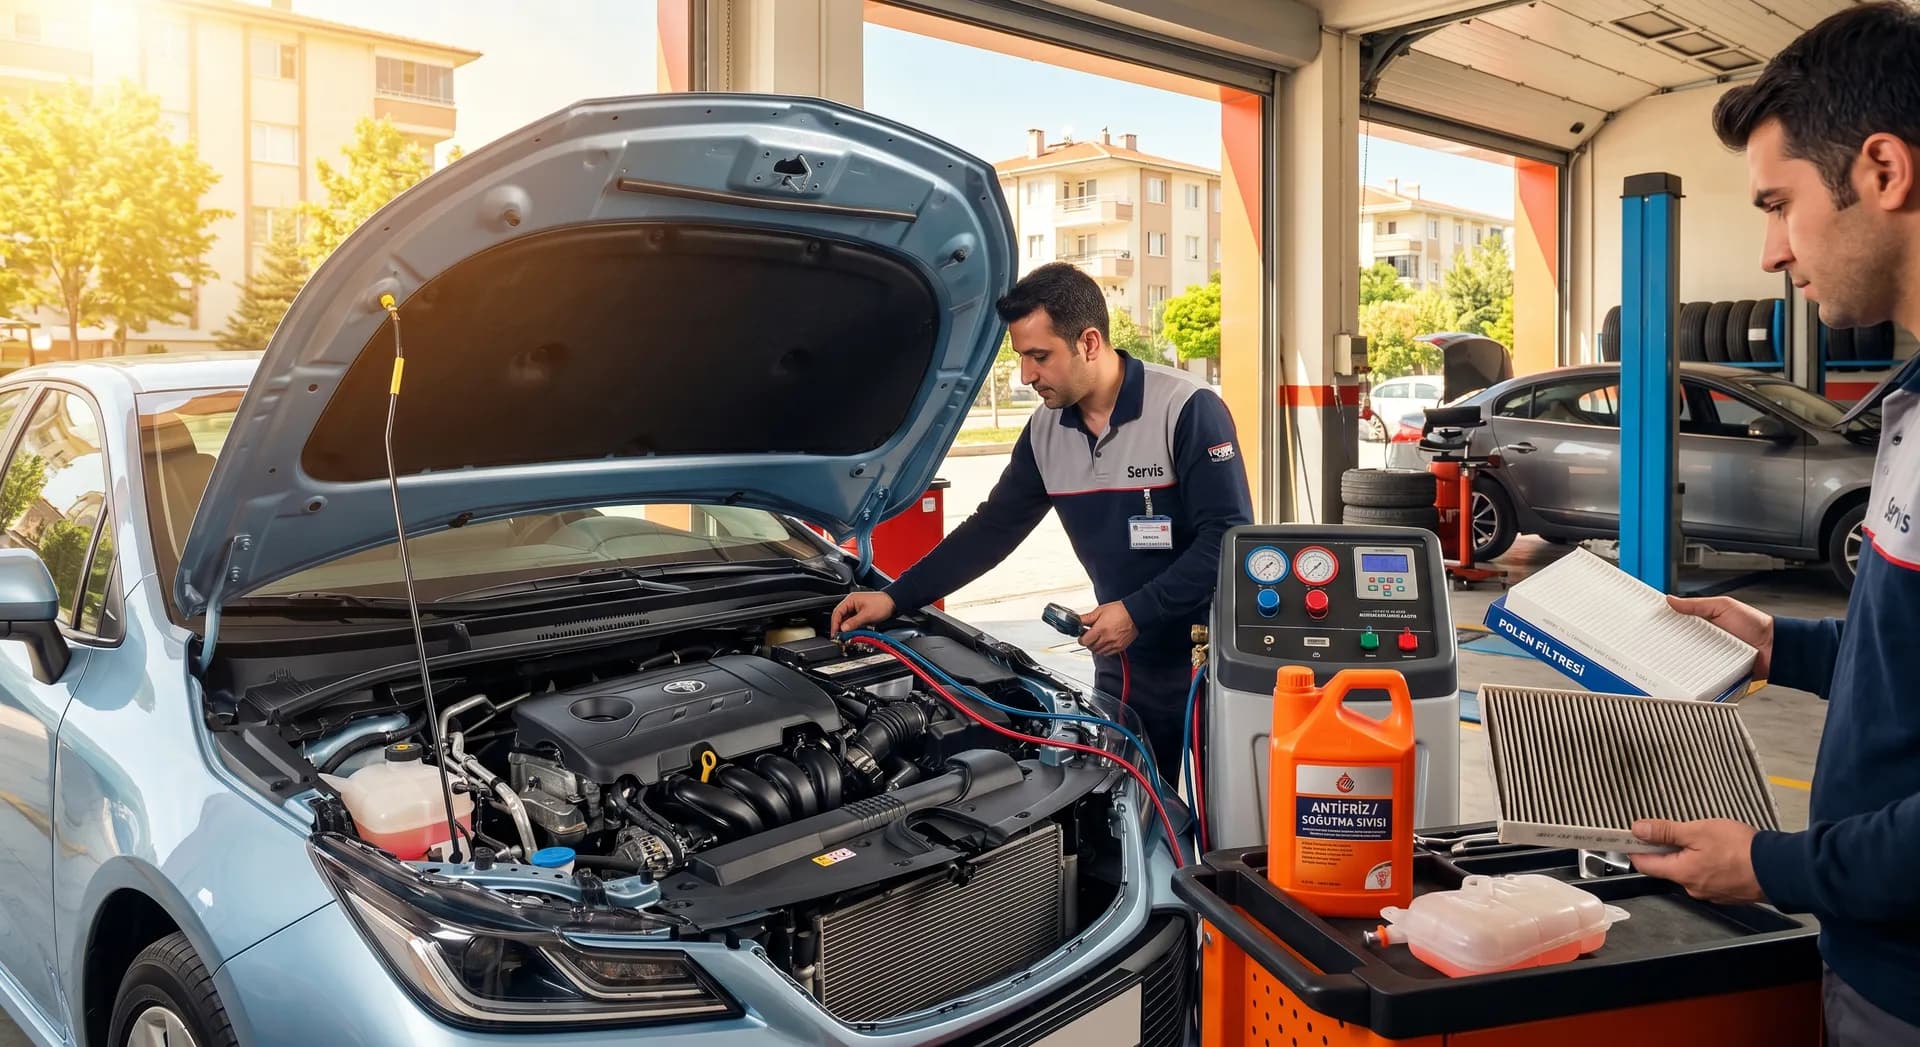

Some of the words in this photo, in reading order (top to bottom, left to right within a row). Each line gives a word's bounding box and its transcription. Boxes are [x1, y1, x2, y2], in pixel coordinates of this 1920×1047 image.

[1127, 463, 1164, 478] Servis
[1498, 618, 1535, 647] POLEN
[1535, 641, 1585, 677] FİLTRESİ
[1311, 800, 1370, 815] ANTİFRİZ
[1302, 814, 1354, 827] SOĞUTMA
[1356, 817, 1386, 828] SIVISI
